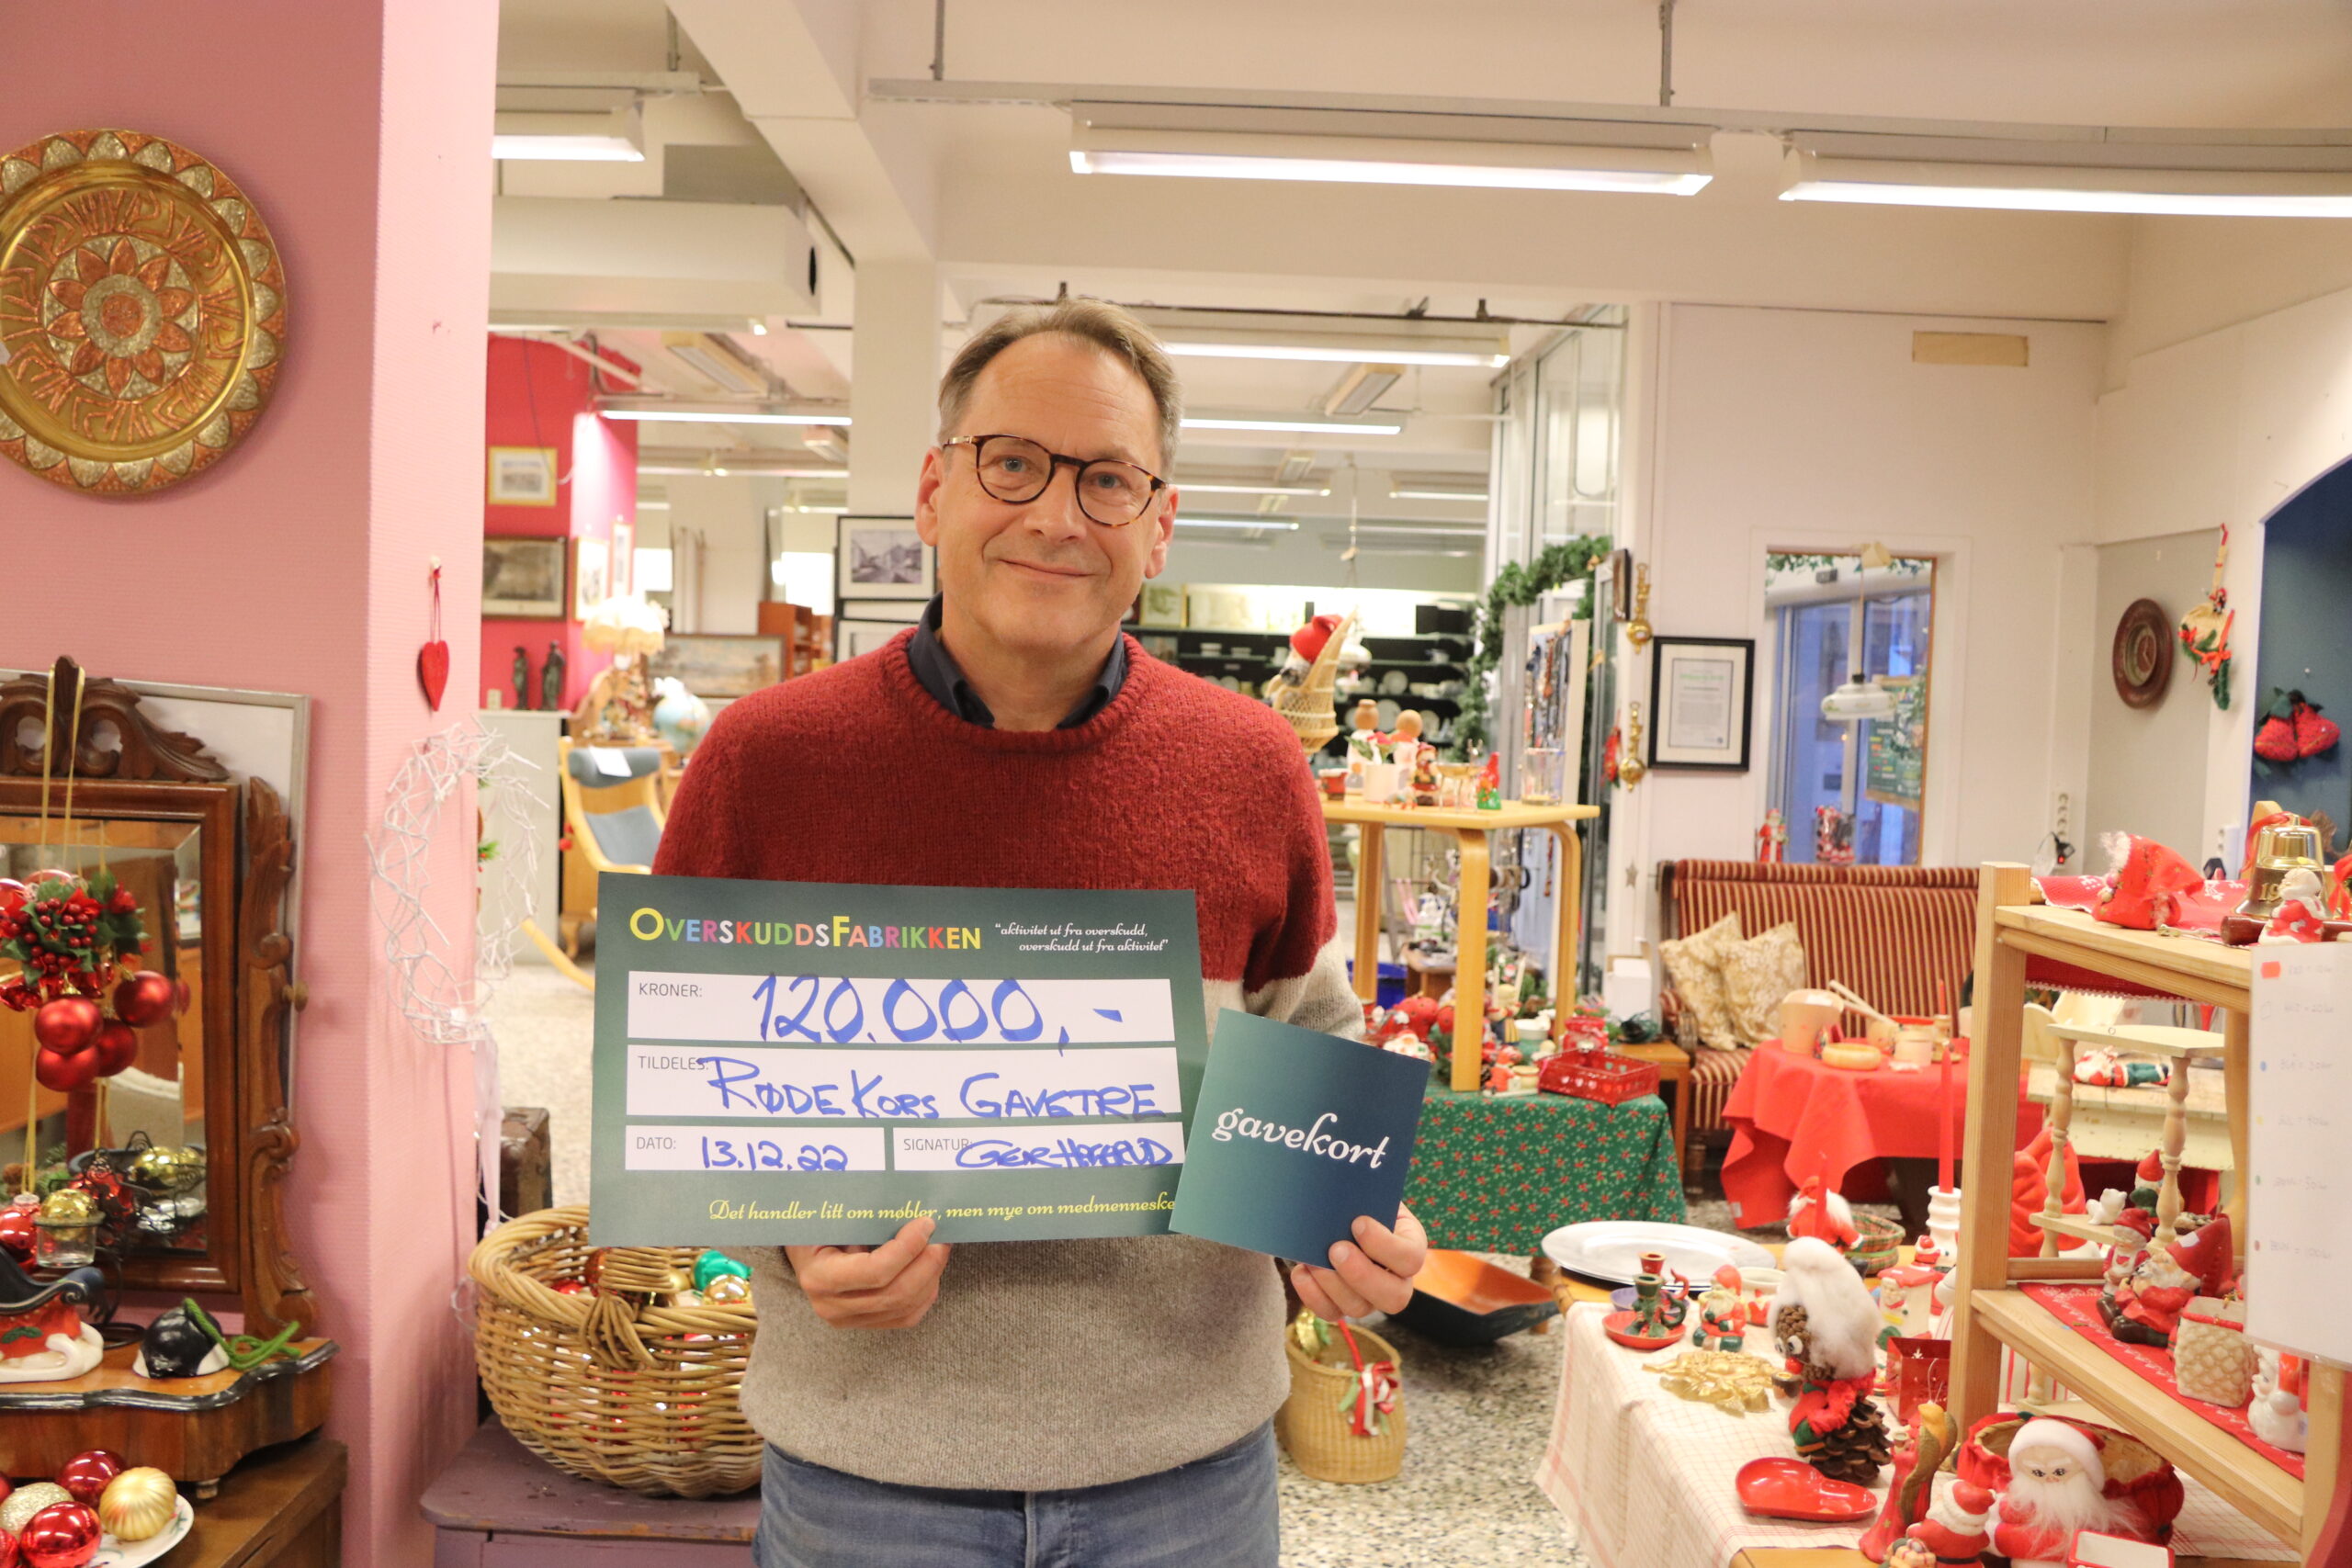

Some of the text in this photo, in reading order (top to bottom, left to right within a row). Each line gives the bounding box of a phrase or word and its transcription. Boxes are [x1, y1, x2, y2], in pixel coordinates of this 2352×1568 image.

[1049, 924, 1062, 936] ut
[1063, 922, 1083, 938] fra
[1085, 922, 1148, 937] overskudd,
[1019, 938, 1080, 952] overskudd
[1082, 940, 1094, 952] ut
[1095, 938, 1115, 953] fra
[639, 982, 702, 997] KRONER:
[638, 1055, 709, 1070] TILDELES:
[696, 1056, 846, 1115] RØDE
[636, 1136, 676, 1150] DATO:
[1211, 1108, 1390, 1169] gavekort
[702, 1136, 848, 1171] 13.12.22
[709, 1200, 745, 1220] Det
[748, 1201, 817, 1220] handler
[820, 1201, 843, 1219] litt
[847, 1209, 874, 1219] om
[877, 1200, 941, 1222] møbler,
[945, 1207, 983, 1218] men
[988, 1206, 1023, 1221] mye
[1027, 1205, 1054, 1215] om
